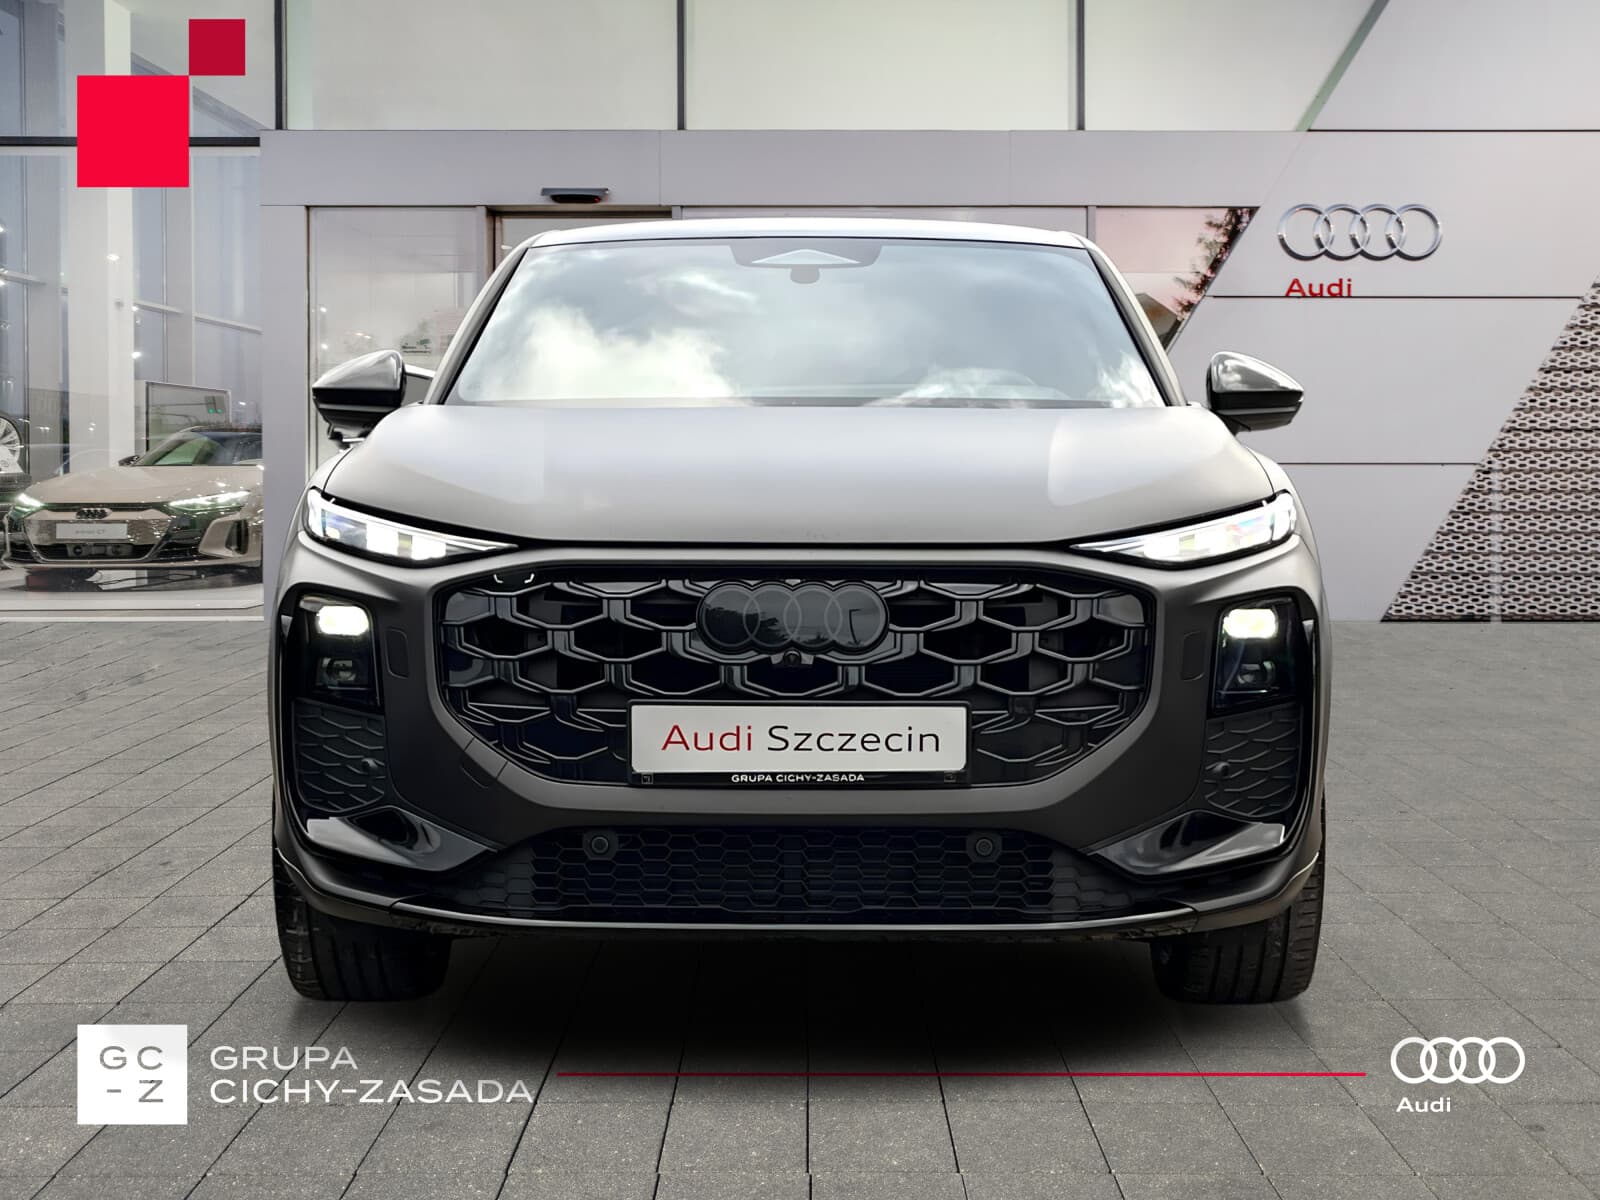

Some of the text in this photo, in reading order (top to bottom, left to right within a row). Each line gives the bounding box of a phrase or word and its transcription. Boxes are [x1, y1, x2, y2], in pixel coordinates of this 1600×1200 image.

[1285, 278, 1353, 297] Audi
[661, 724, 941, 753] Audi Szczecin
[731, 773, 865, 783] GRUPA CICHY-ZASADA
